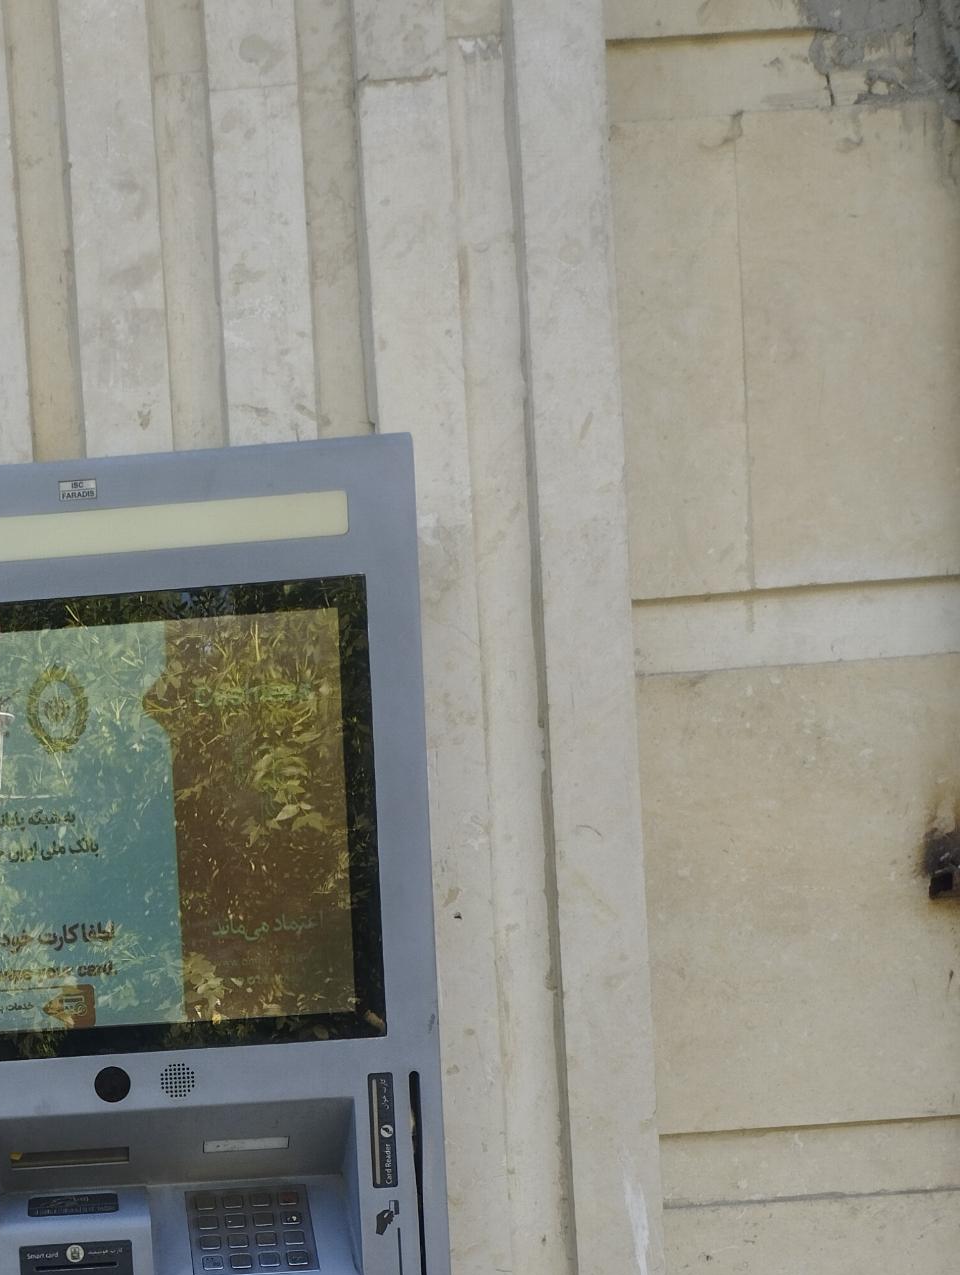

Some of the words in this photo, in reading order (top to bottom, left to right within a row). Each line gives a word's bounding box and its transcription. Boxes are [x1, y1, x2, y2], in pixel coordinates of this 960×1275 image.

[61, 490, 95, 500] FARADIS
[39, 923, 80, 950] کارت
[384, 1144, 393, 1168] Reader
[26, 1252, 45, 1260] Smart
